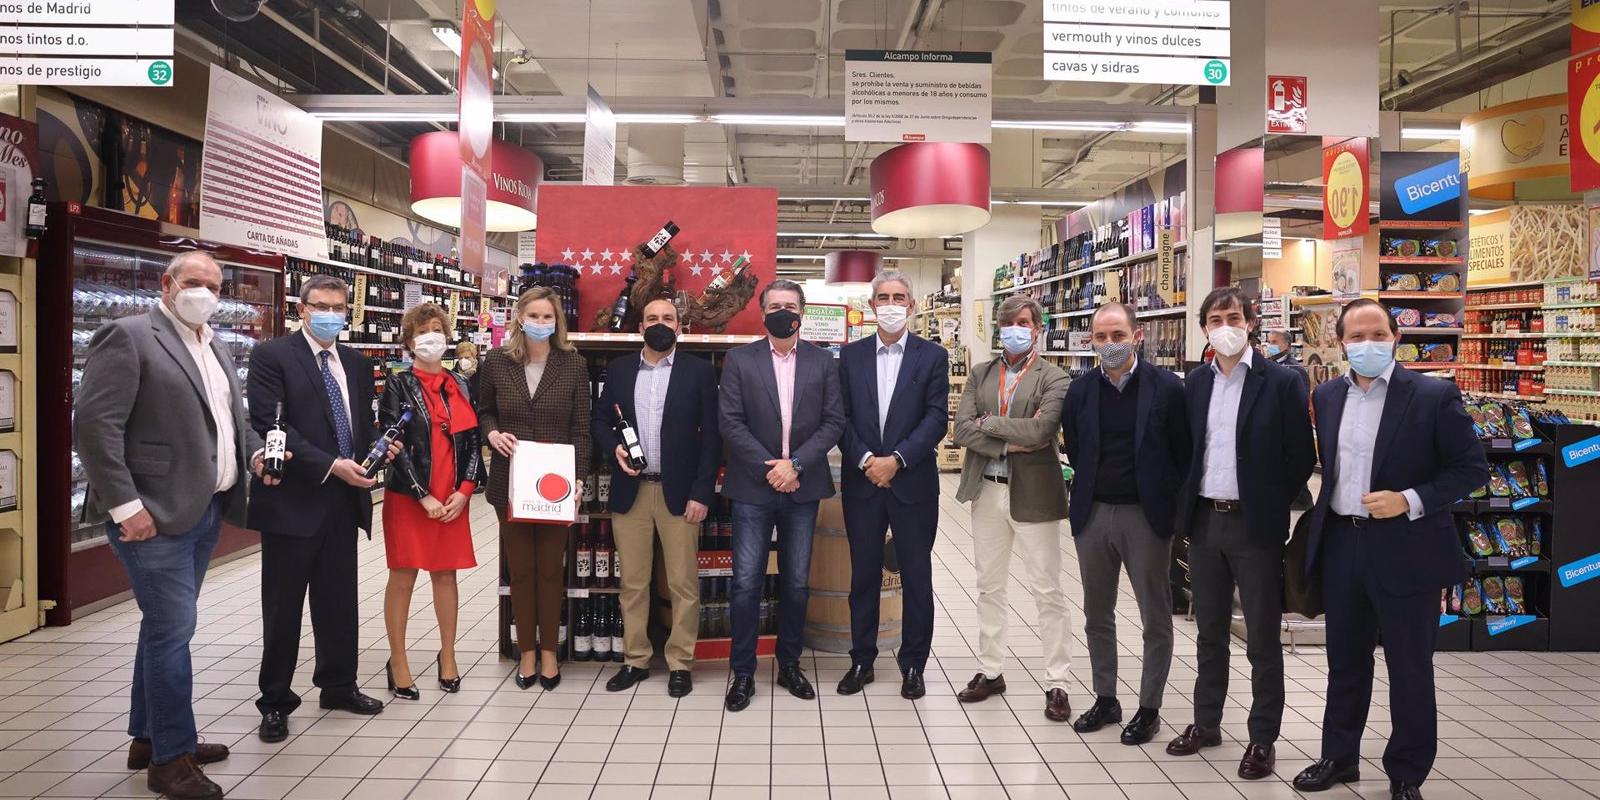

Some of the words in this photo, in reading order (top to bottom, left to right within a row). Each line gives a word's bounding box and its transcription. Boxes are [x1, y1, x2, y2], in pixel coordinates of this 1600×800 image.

[27, 3, 43, 14] de
[46, 2, 91, 15] Madrid
[27, 33, 62, 45] tintos
[66, 34, 89, 46] d.o.
[1052, 31, 1112, 43] vermouth
[1115, 34, 1123, 46] y
[1126, 34, 1158, 45] vinos
[1162, 35, 1202, 47] dulces
[884, 52, 920, 62] Alcampo
[921, 52, 953, 61] Informa
[27, 65, 42, 76] de
[46, 65, 102, 79] prestigio
[1052, 61, 1088, 71] cavas
[1091, 62, 1098, 74] y
[1101, 61, 1140, 73] sidras
[152, 69, 168, 81] 32
[1207, 69, 1223, 80] 30
[493, 172, 517, 195] VINOS
[247, 230, 267, 243] CARTA
[267, 234, 275, 245] DE
[276, 236, 299, 249] AÑADAS
[1500, 234, 1504, 243] Y
[1160, 233, 1172, 291] champagne
[522, 503, 562, 513] madrid
